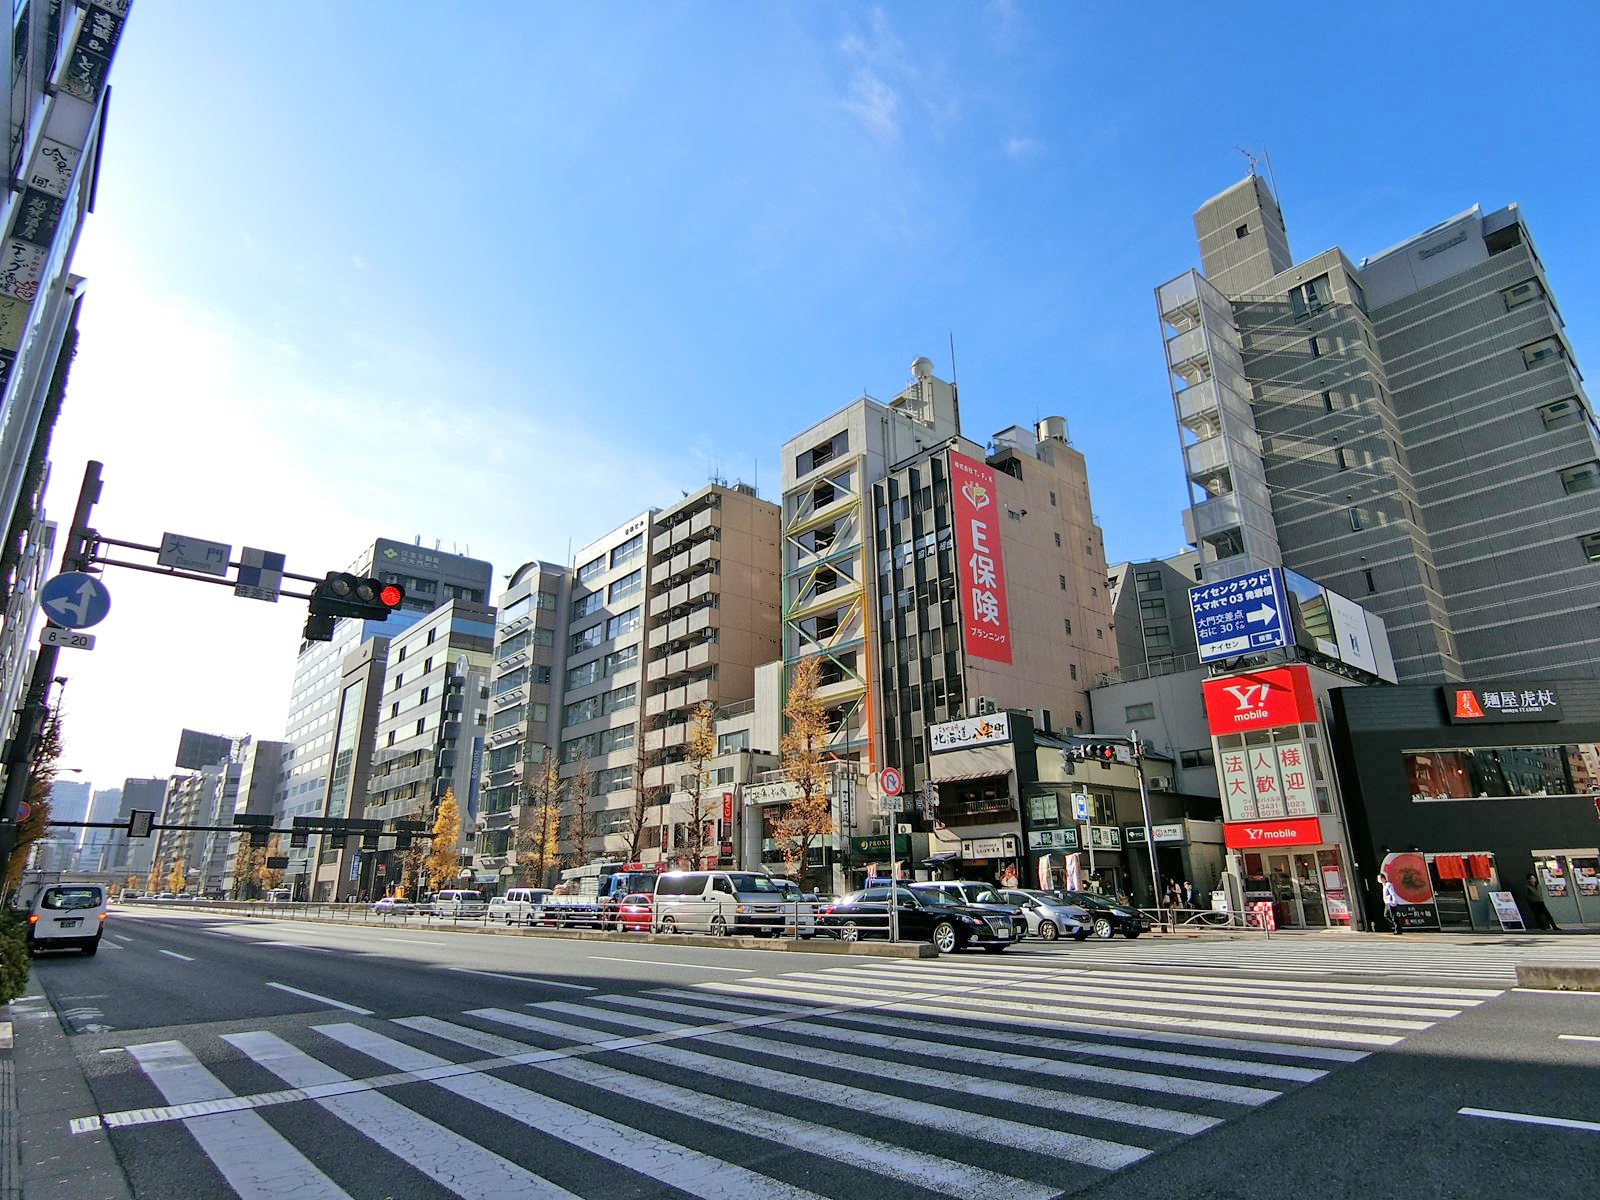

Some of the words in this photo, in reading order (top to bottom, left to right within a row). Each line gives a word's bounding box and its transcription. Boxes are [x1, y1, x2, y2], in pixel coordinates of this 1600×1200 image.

[167, 541, 225, 563] 大門
[176, 556, 212, 570] Daimon
[969, 519, 999, 626] E保険
[1192, 574, 1270, 602] ナイセンクラウド
[1194, 597, 1228, 613] スマホで
[1229, 593, 1244, 604] 03
[1198, 609, 1245, 628] 大門交差点
[1199, 627, 1218, 639] 右に
[1220, 623, 1233, 634] 30
[1210, 641, 1239, 652] ナイセン
[1223, 684, 1270, 710] Y!
[1233, 710, 1269, 722] mobile
[1225, 748, 1302, 773] 法人様
[1229, 772, 1306, 796] 大歓迎
[869, 839, 892, 847] PRONT
[1244, 828, 1264, 840] Y!
[1264, 829, 1297, 839] mobile
